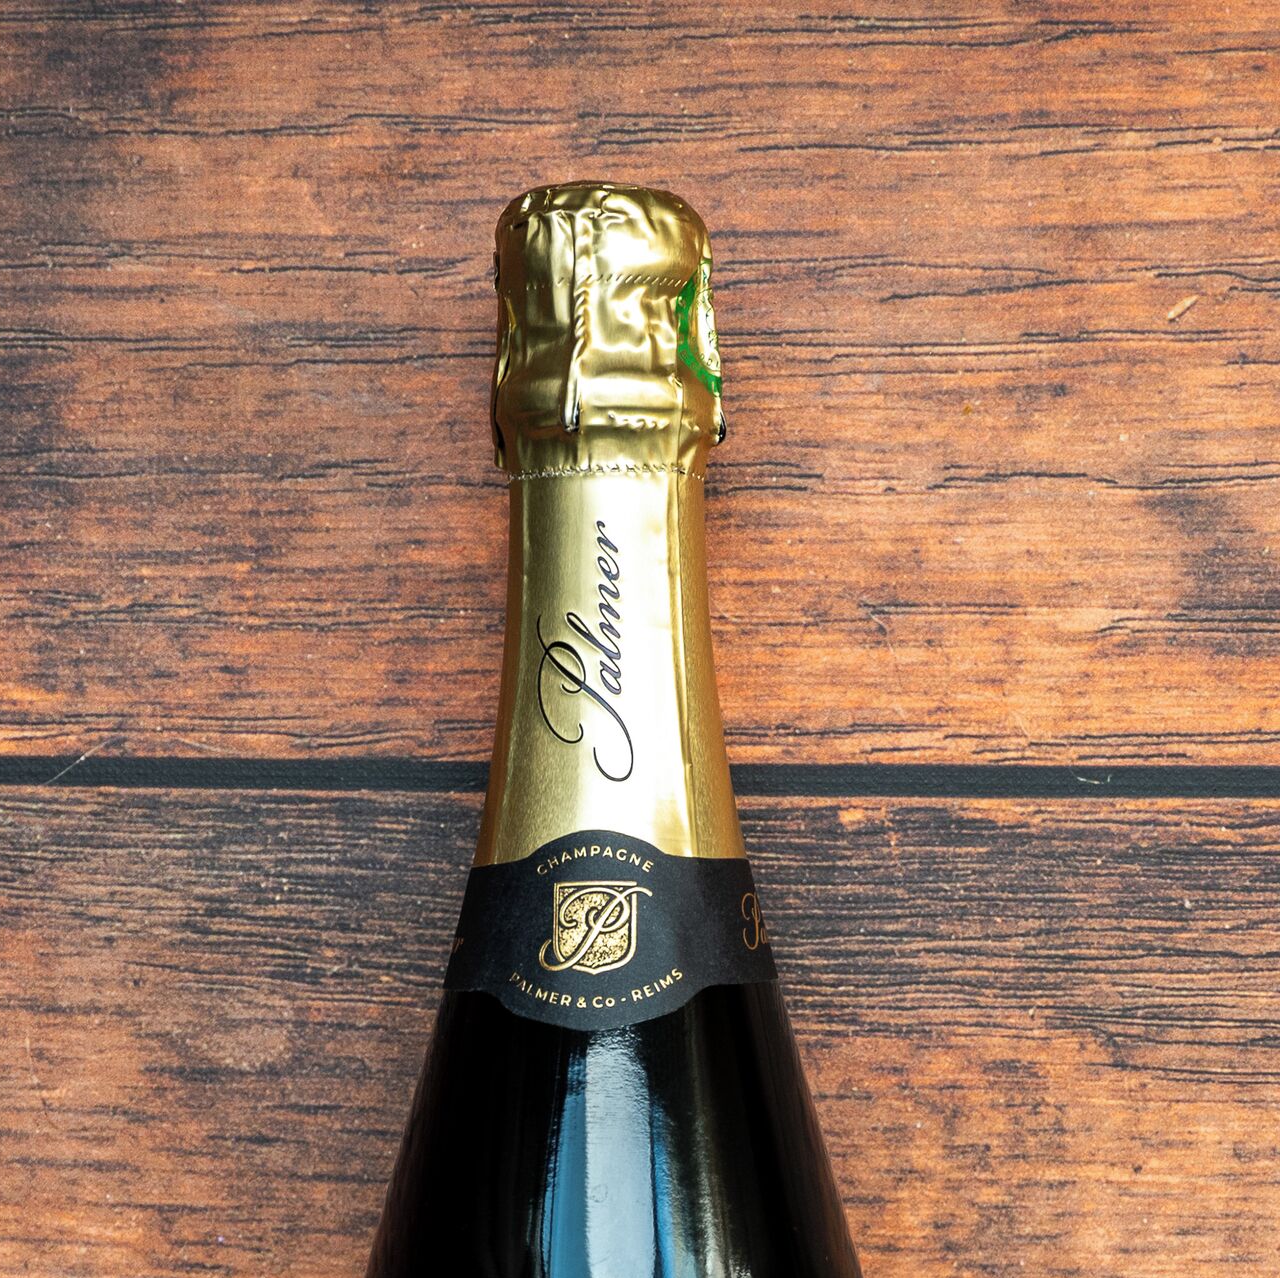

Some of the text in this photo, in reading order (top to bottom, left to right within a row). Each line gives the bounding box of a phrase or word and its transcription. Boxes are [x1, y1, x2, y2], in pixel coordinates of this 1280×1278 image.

[536, 520, 634, 783] Palmer
[536, 845, 655, 876] CHAMPAGNE
[508, 971, 572, 1007] PALMER
[576, 996, 587, 1008] &
[592, 996, 616, 1008] Co
[631, 967, 684, 1003] REIMS
